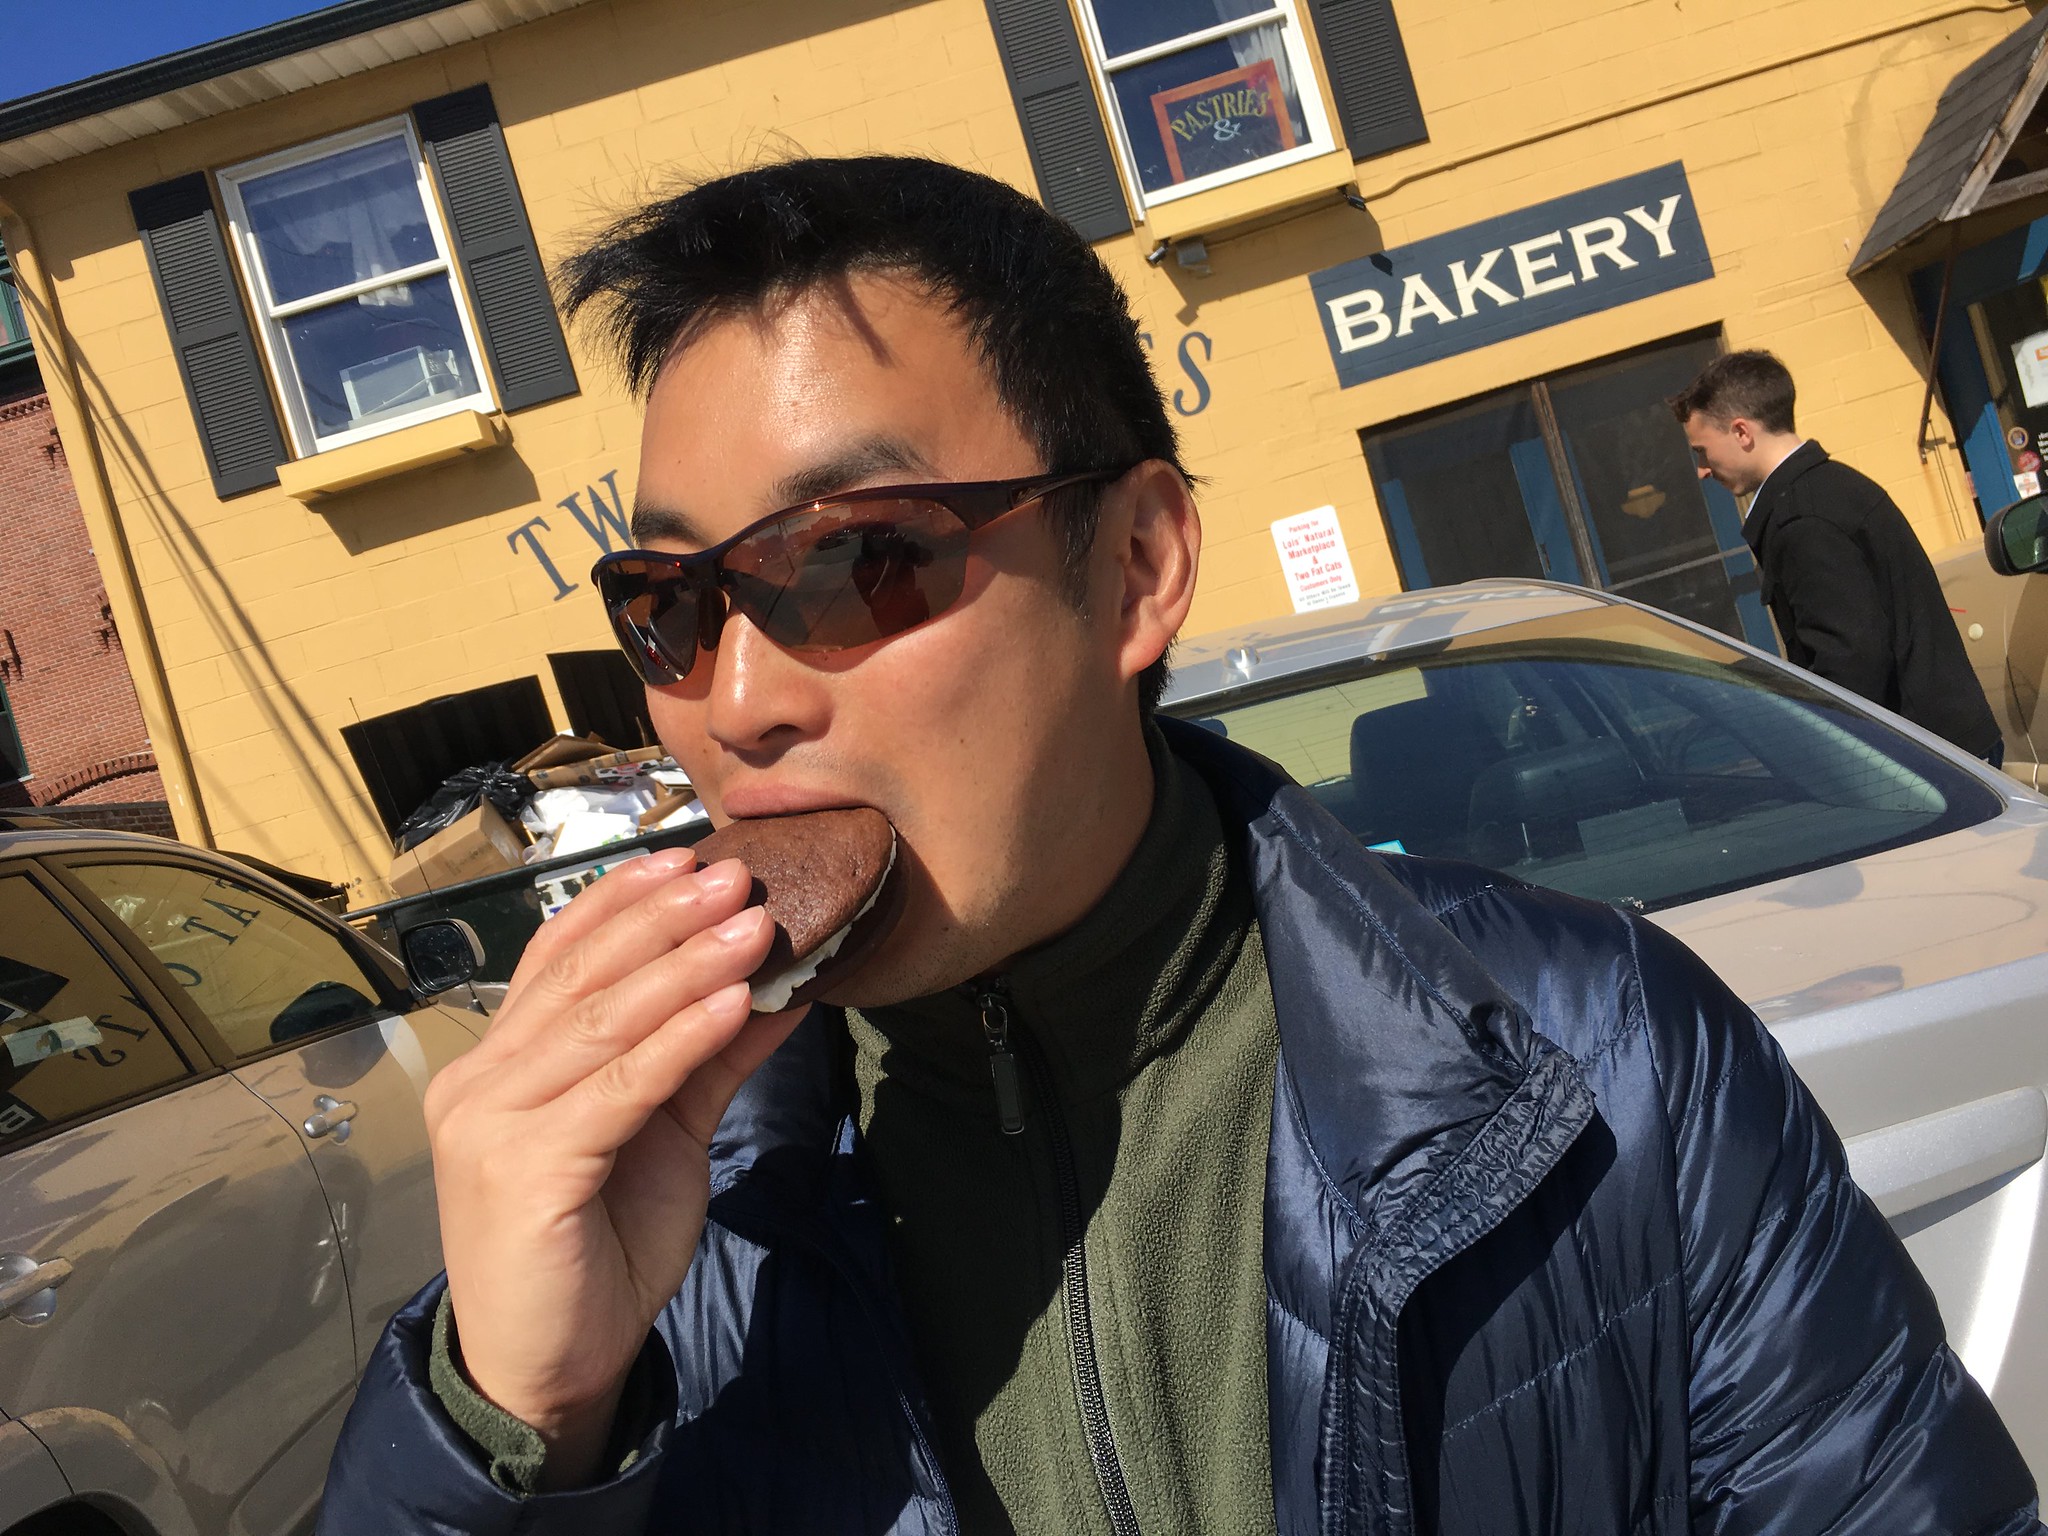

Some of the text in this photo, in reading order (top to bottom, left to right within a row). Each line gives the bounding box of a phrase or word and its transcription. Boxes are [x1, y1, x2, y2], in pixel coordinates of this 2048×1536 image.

[1170, 87, 1272, 142] PASTRIES
[1213, 118, 1242, 142] &
[1325, 194, 1683, 353] BAKERY
[506, 469, 635, 601] TW
[1288, 523, 1310, 533] Parking
[1304, 527, 1335, 542] Natural
[1288, 540, 1336, 559] Marketplace
[1294, 562, 1342, 581] Two Fat Cats
[1300, 575, 1342, 591] Customers Only
